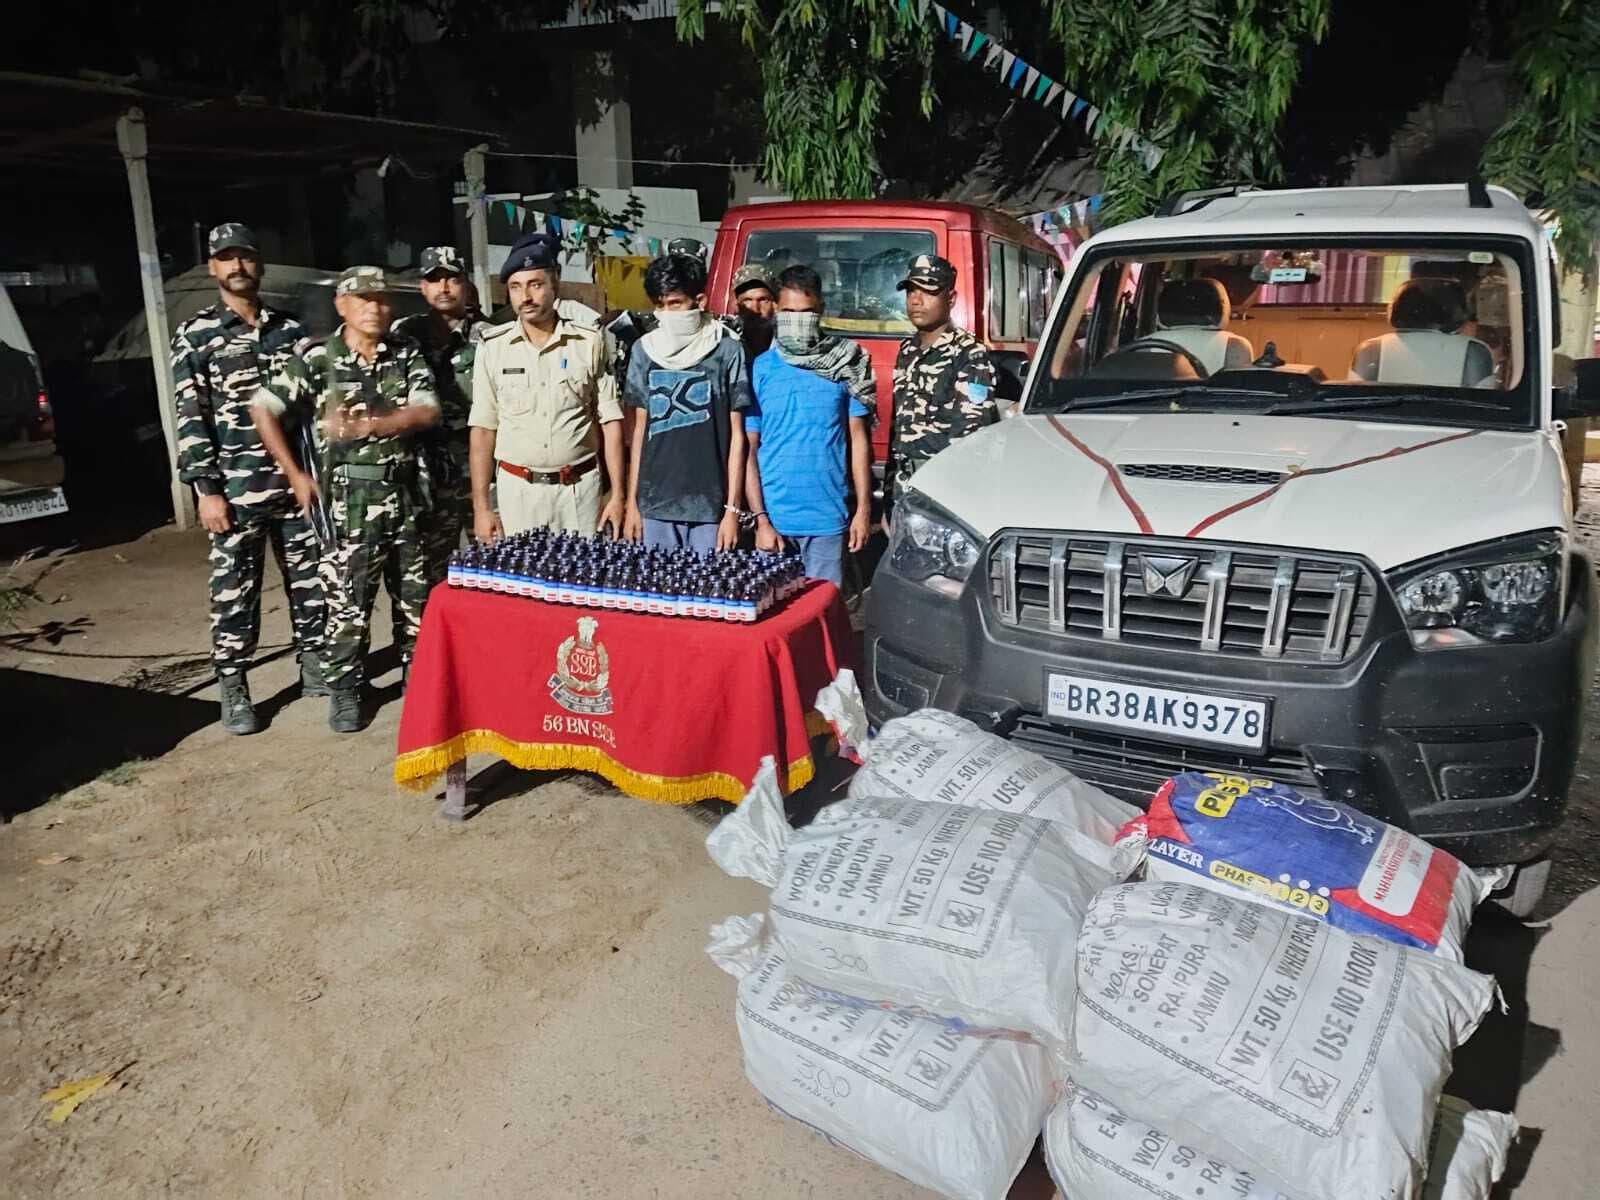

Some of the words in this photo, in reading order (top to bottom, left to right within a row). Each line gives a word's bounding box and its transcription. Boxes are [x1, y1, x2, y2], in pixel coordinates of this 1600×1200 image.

[542, 714, 563, 733] 56
[565, 716, 590, 736] BN
[1067, 684, 1261, 738] BR38AK9378
[957, 764, 977, 782] 50
[992, 775, 1026, 806] USE
[814, 835, 853, 894] SONEPAT
[837, 837, 878, 899] RAJPURA
[976, 839, 1008, 863] NO
[861, 853, 894, 904] JAMMU
[911, 867, 936, 887] 50
[959, 861, 996, 896] USE
[1133, 932, 1180, 1003] SONEPAT
[1253, 1004, 1282, 1032] 50
[1275, 942, 1310, 982] WHEN
[1342, 940, 1379, 990] HOOK
[1187, 970, 1231, 1033] JAMMU
[1331, 985, 1365, 1020] NO
[1311, 1013, 1355, 1062] USE
